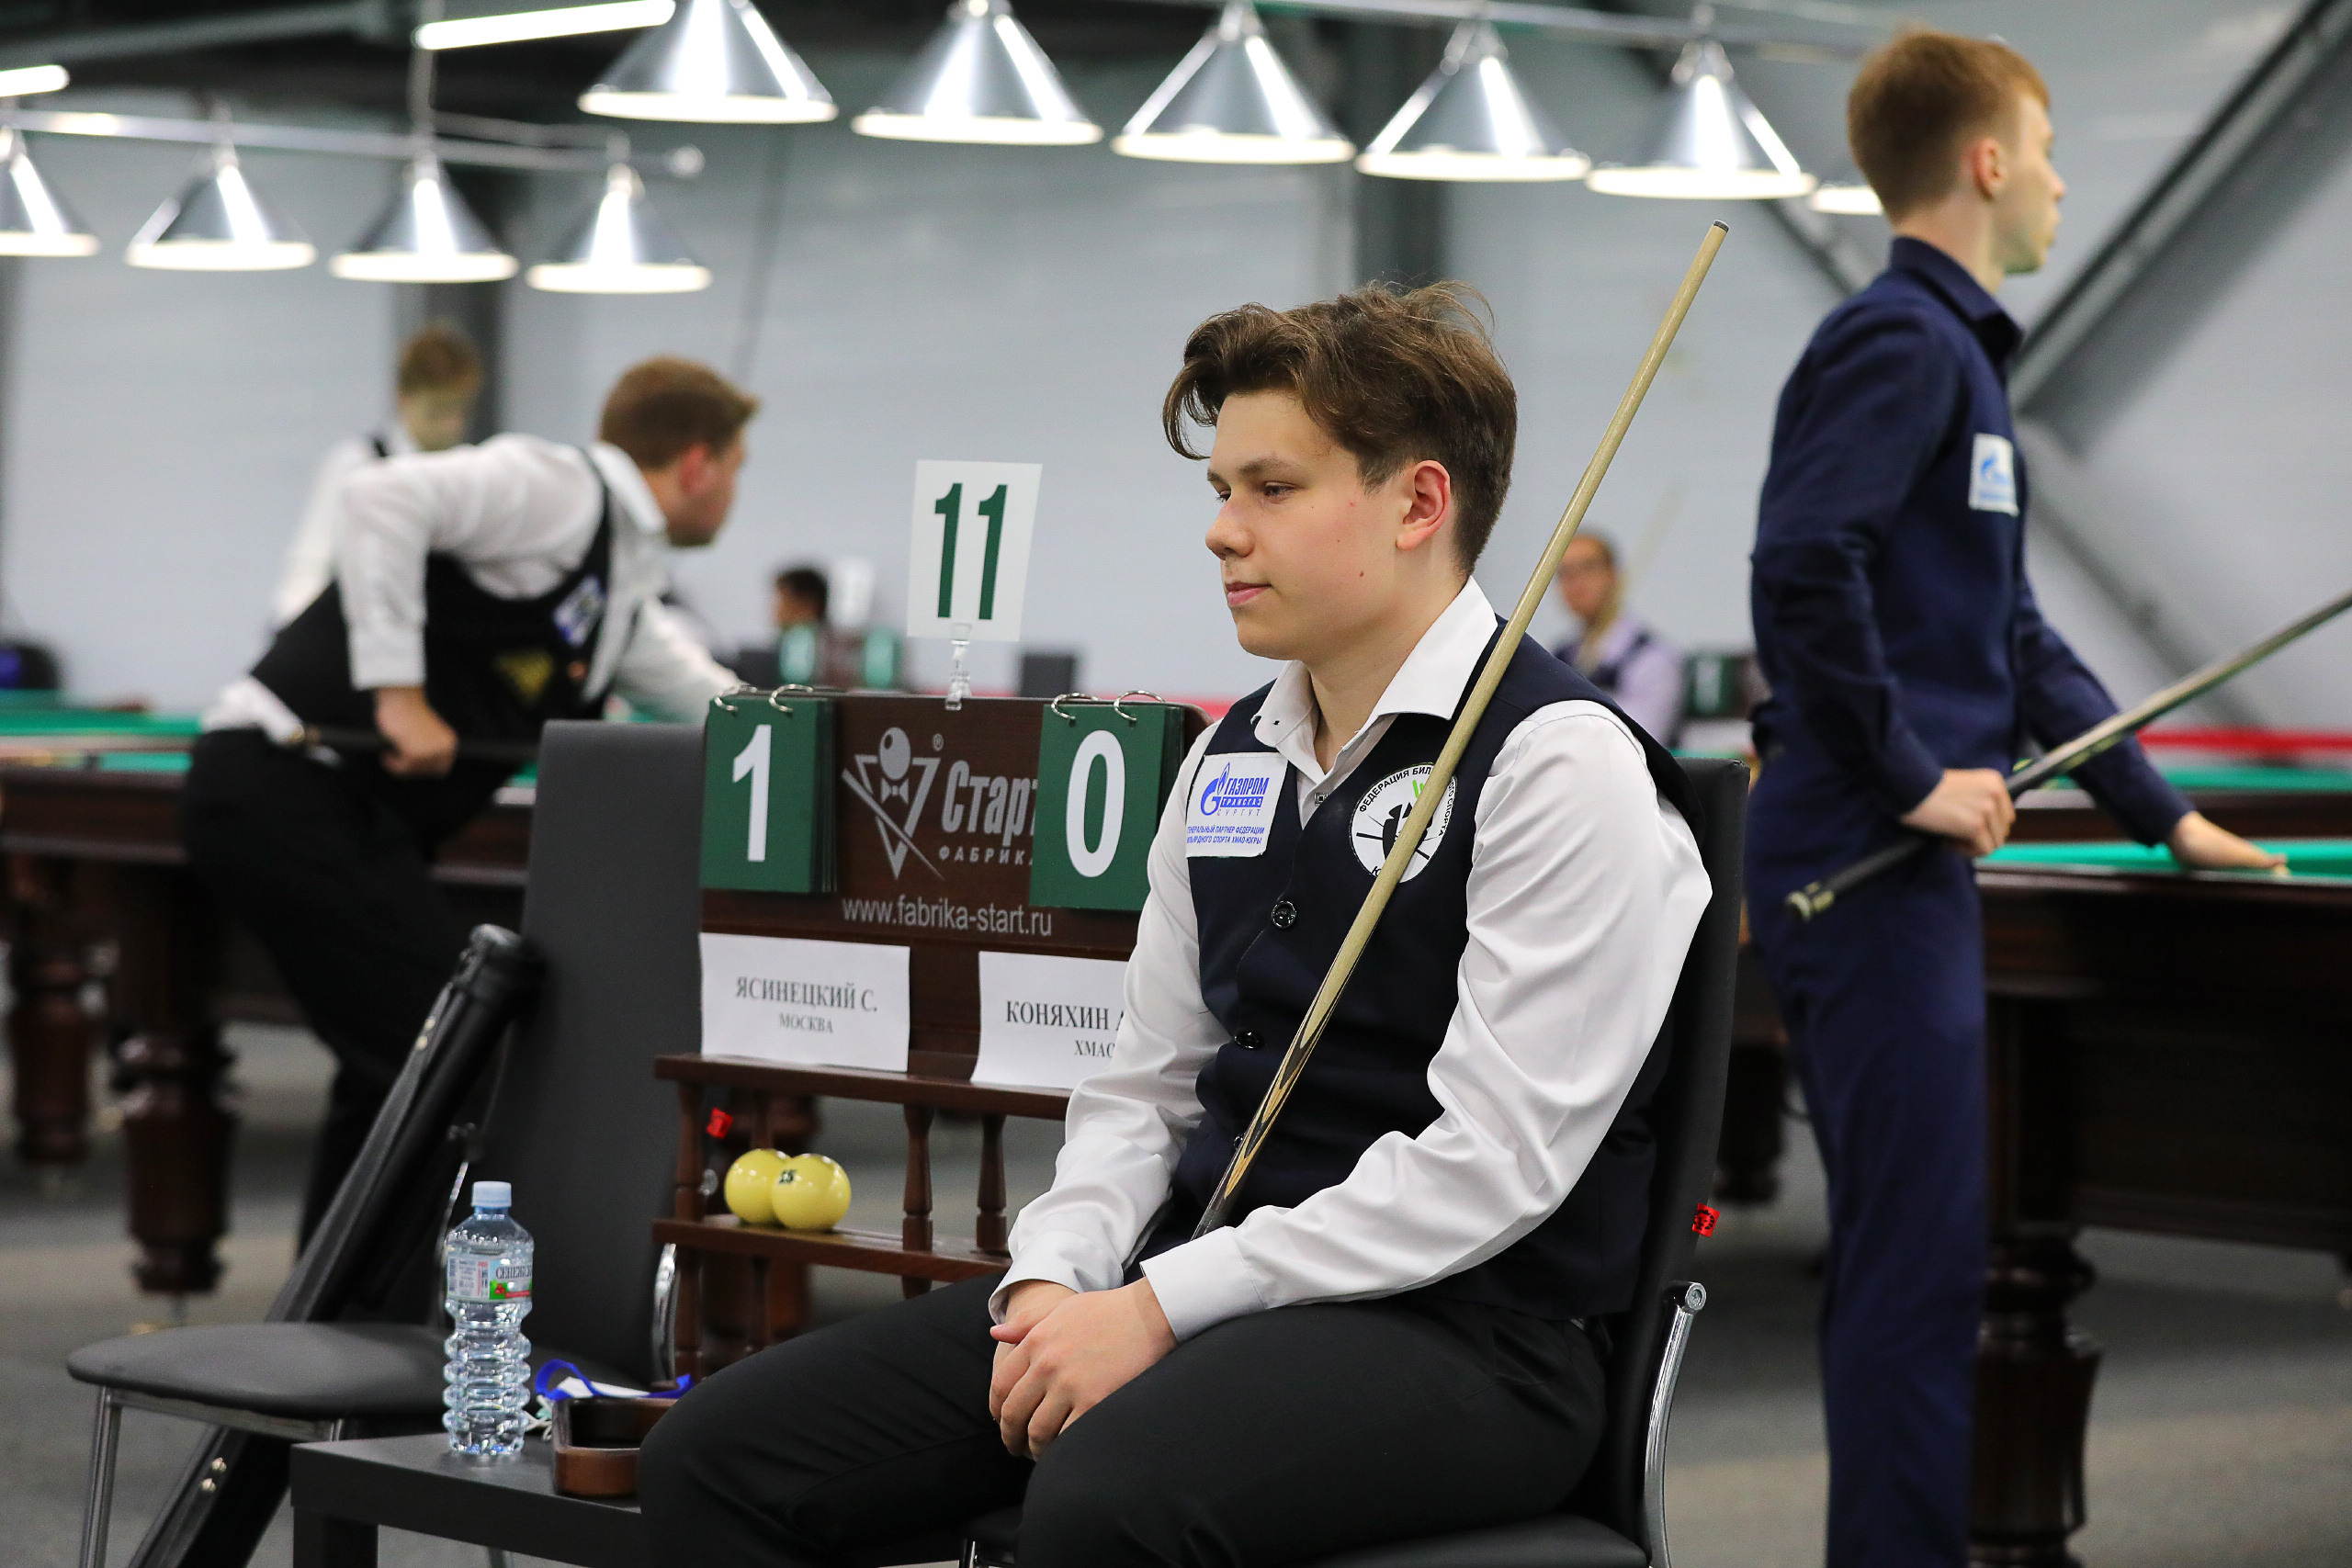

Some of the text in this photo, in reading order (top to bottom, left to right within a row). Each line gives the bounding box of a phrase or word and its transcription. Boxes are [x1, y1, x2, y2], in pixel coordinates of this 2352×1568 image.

[934, 482, 1009, 620] 11
[732, 724, 772, 863] 1
[1224, 777, 1270, 795] ГАЗПРОМ
[1359, 770, 1409, 813] ФЕДЕРАЦИЯ
[1066, 729, 1125, 878] 0
[1216, 808, 1261, 817] СУРГУТ
[1222, 797, 1262, 807] ТРАНСГАЗ
[1216, 826, 1235, 834] ПАРТНЕР
[1236, 826, 1265, 835] ФЕДЕРАЦИИ
[1231, 836, 1262, 844] ХМАО-ЮГРЫ
[939, 845, 1033, 865] ФАБРИК
[842, 893, 1052, 937] www.fabrika-start.ru
[736, 976, 877, 1011] ЯСИНЕЦКИЙ С.
[780, 1012, 833, 1033] МОСКВА
[1006, 1000, 1110, 1031] КОНЯХИН
